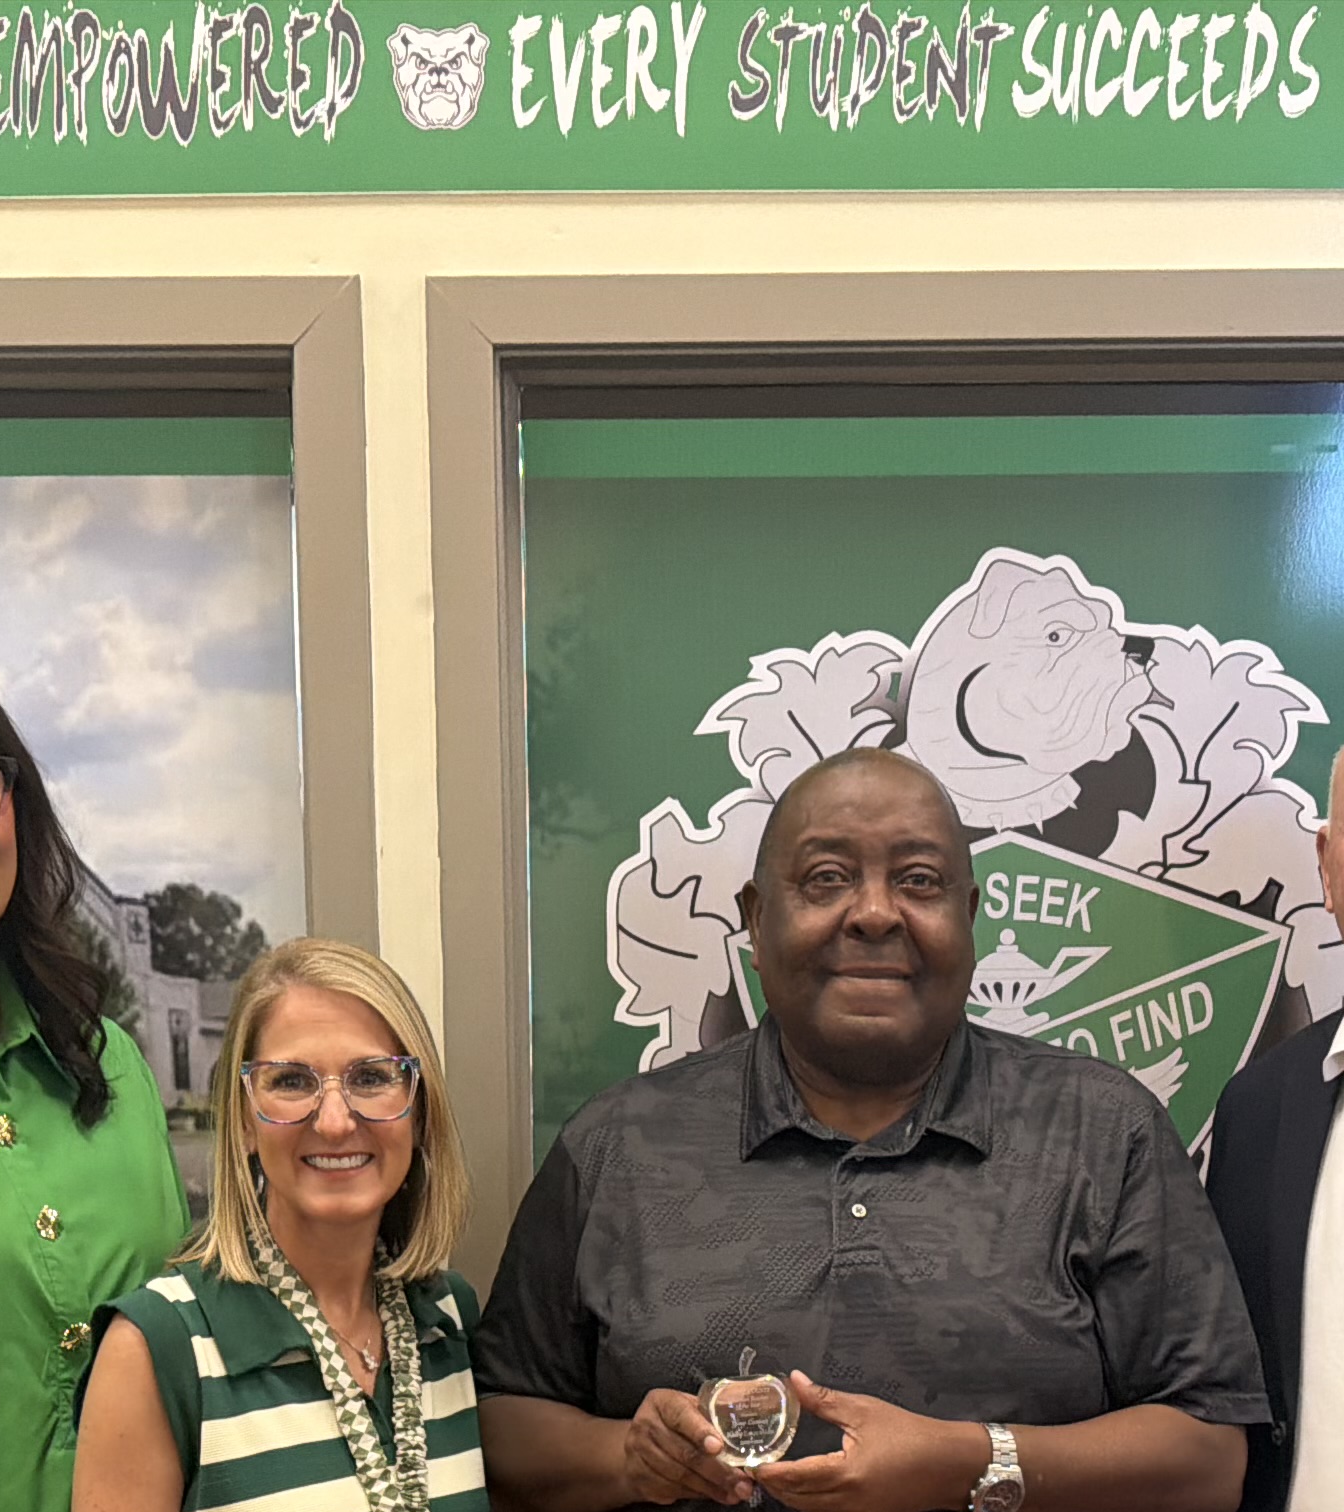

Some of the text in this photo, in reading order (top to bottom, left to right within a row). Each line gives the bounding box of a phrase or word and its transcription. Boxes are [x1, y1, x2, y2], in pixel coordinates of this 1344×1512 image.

[508, 1, 706, 138] EVERY
[728, 4, 1014, 132] STUDENT
[1012, 5, 1321, 124] SUCCEEDS
[984, 872, 1101, 933] SEEK
[1109, 981, 1214, 1062] FIND
